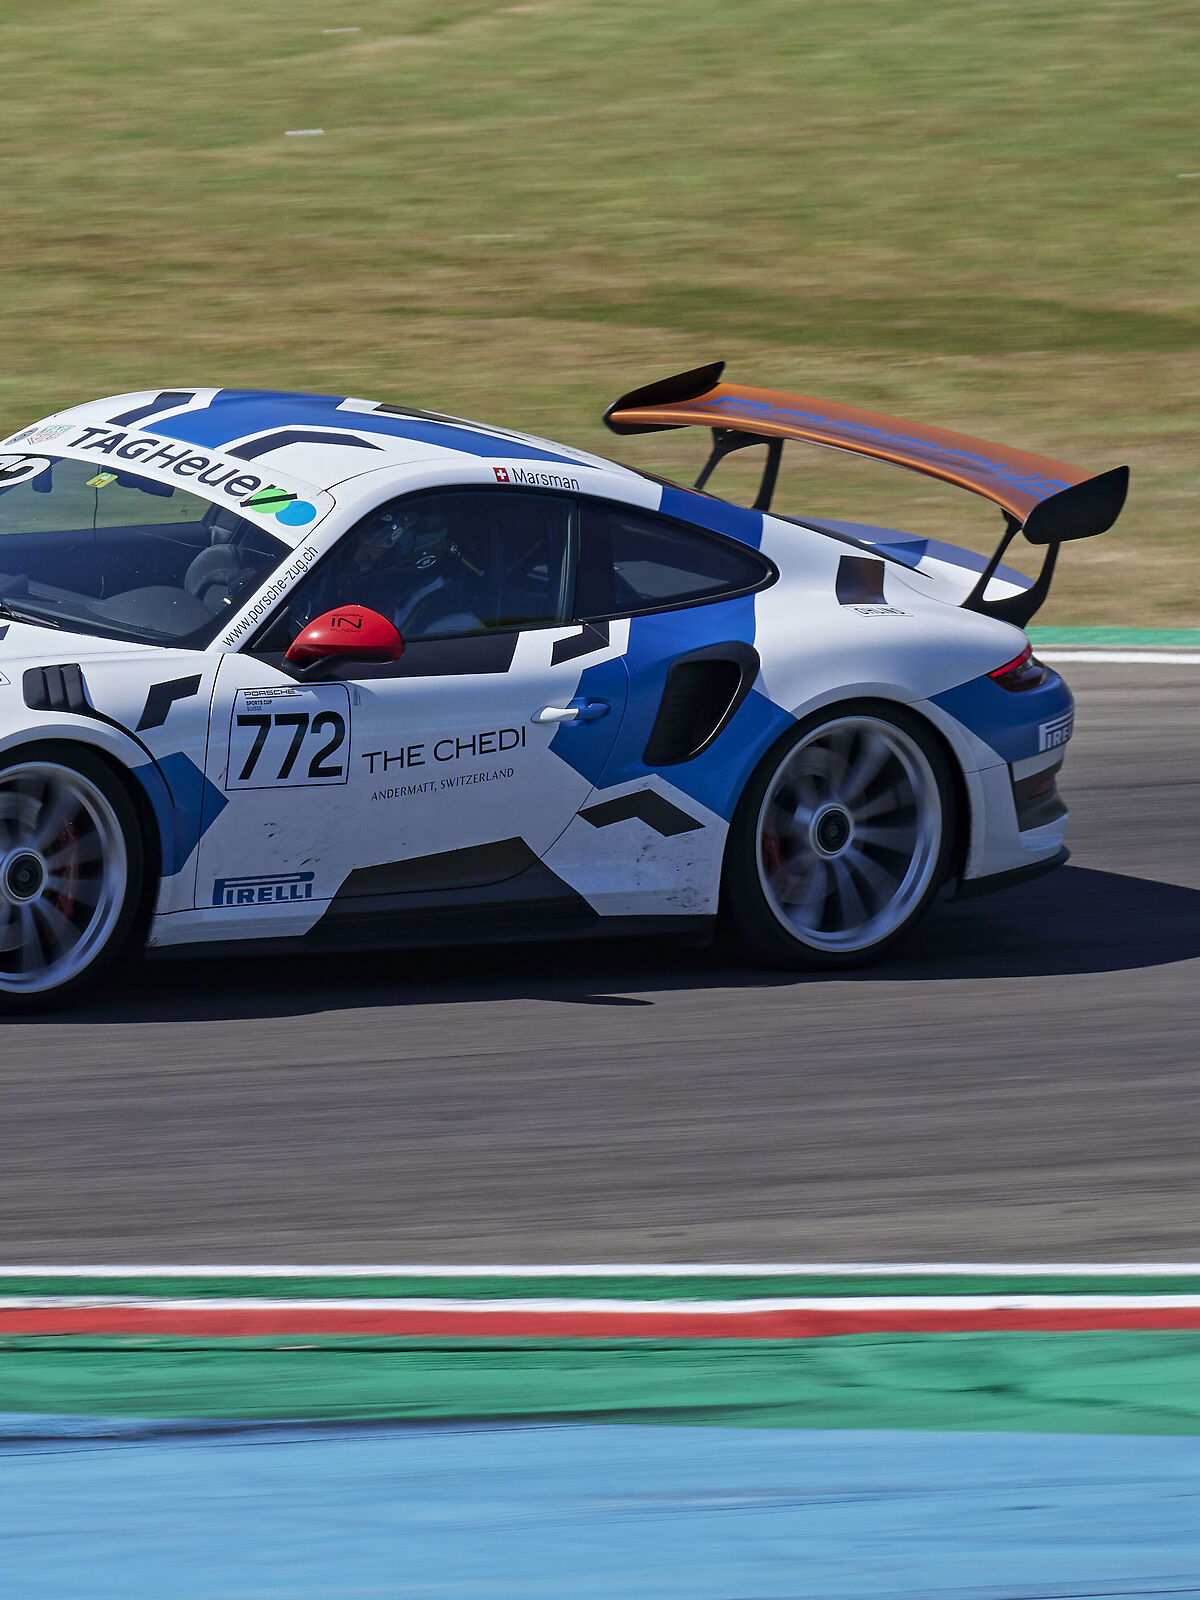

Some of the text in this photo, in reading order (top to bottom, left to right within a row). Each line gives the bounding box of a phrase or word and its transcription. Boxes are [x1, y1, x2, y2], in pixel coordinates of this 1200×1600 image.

[511, 467, 580, 490] Marsman
[222, 546, 319, 647] www.porsche-zug.ch
[331, 617, 362, 629] IN
[244, 688, 296, 697] PORSCHE
[236, 710, 346, 780] 772
[362, 725, 526, 774] THE CHEDI
[370, 767, 515, 801] ANDERMATT, SWITZERLAND
[212, 871, 315, 906] PIRELLI
